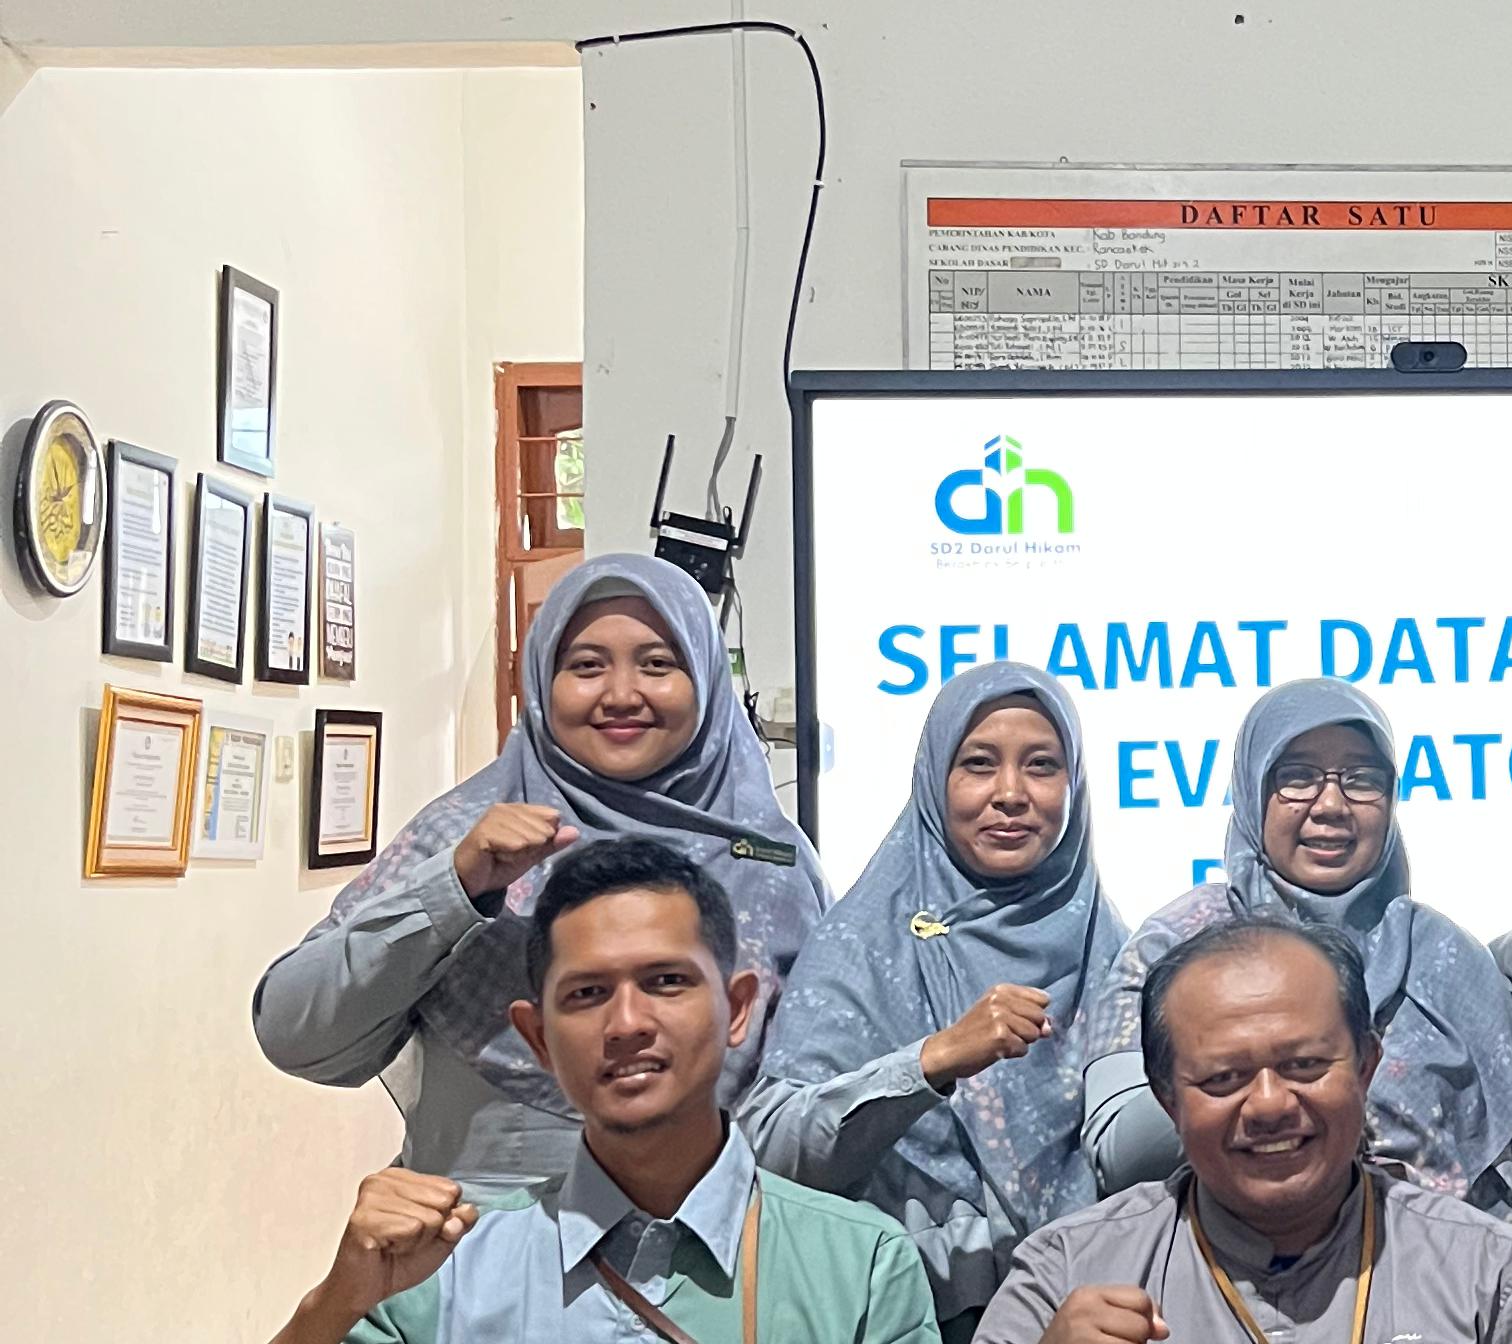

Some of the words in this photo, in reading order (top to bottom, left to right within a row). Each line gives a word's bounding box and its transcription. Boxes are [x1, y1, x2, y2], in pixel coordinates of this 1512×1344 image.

[1180, 205, 1321, 226] DAFTAR
[1348, 205, 1437, 227] SATU
[1487, 274, 1510, 288] SK
[1016, 287, 1052, 297] NAMA
[930, 542, 963, 555] SD2
[970, 541, 1018, 555] Darul
[1025, 541, 1081, 555] Hikam
